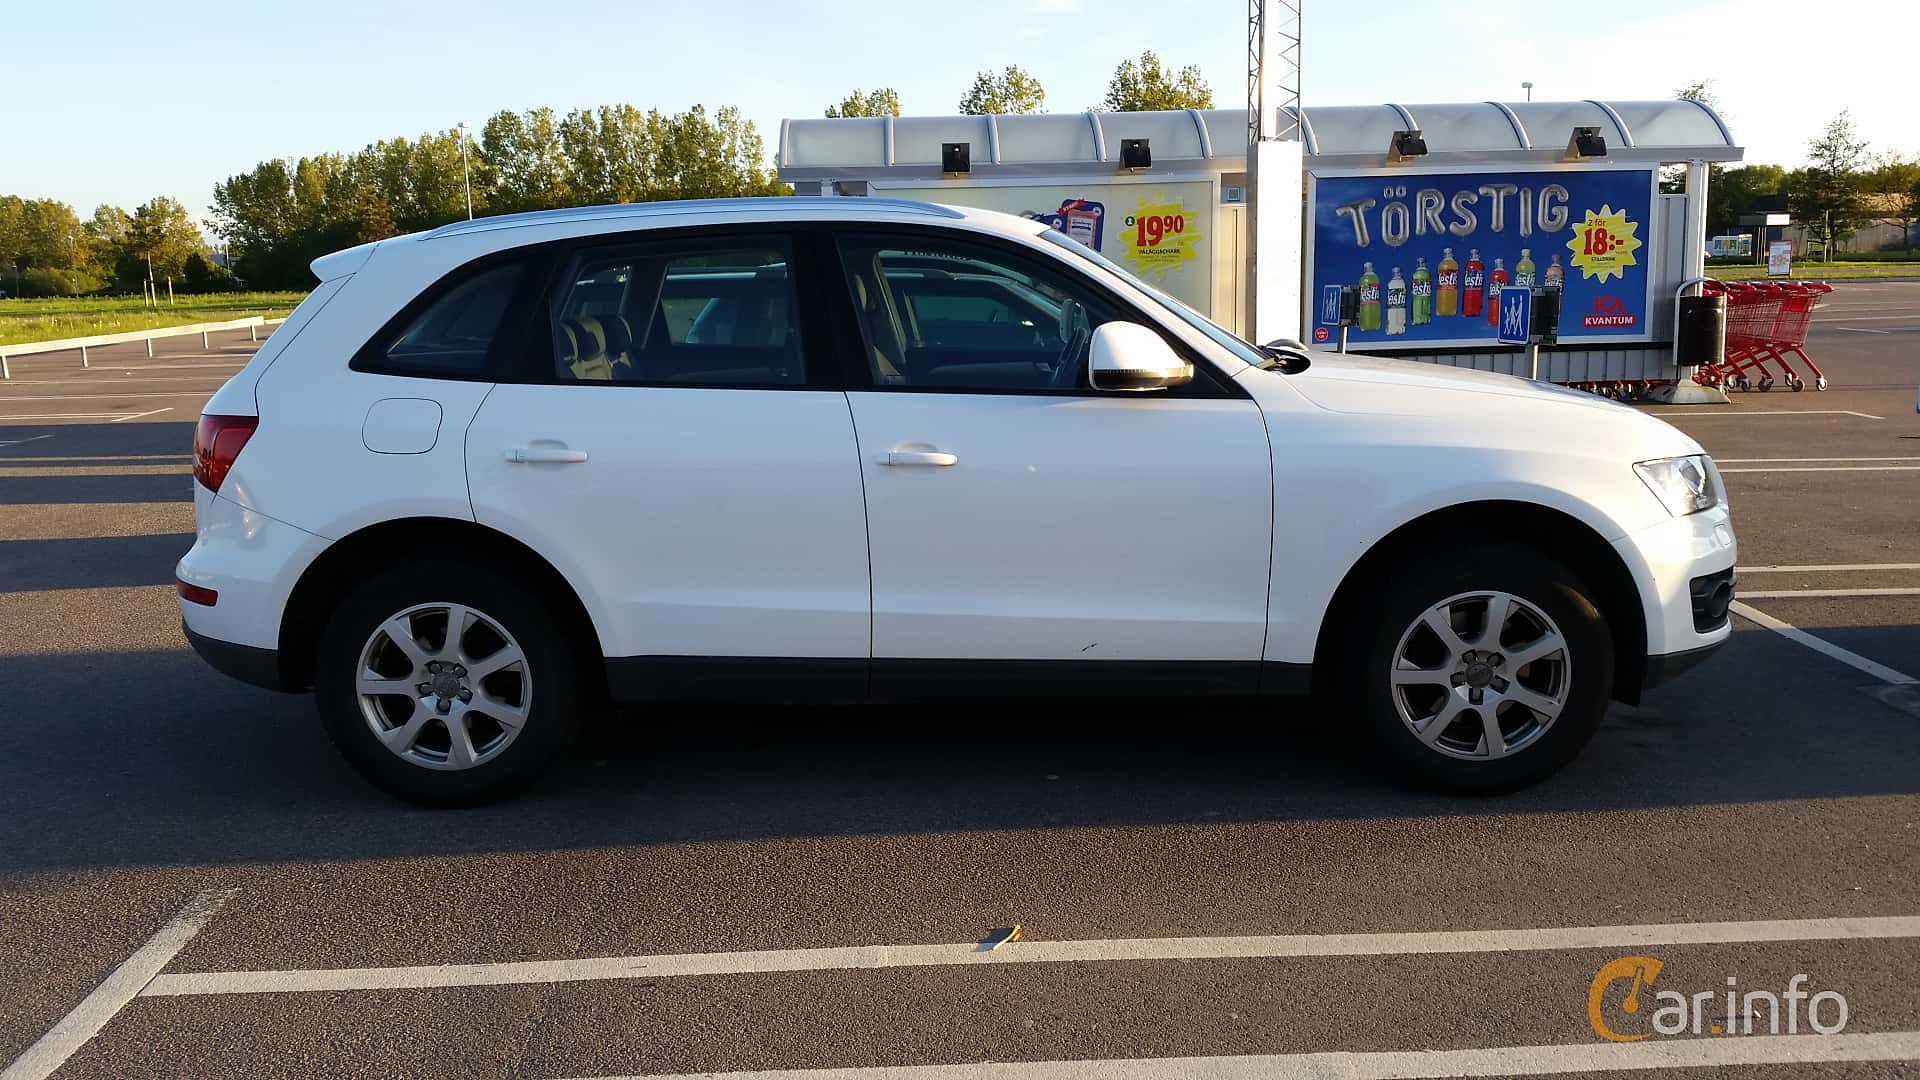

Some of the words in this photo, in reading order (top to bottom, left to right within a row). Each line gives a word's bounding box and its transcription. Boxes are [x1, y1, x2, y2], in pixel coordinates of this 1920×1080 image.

[1336, 184, 1569, 247] TÖRSTIG
[1594, 296, 1624, 312] ICA
[1586, 316, 1633, 326] KVANTUM
